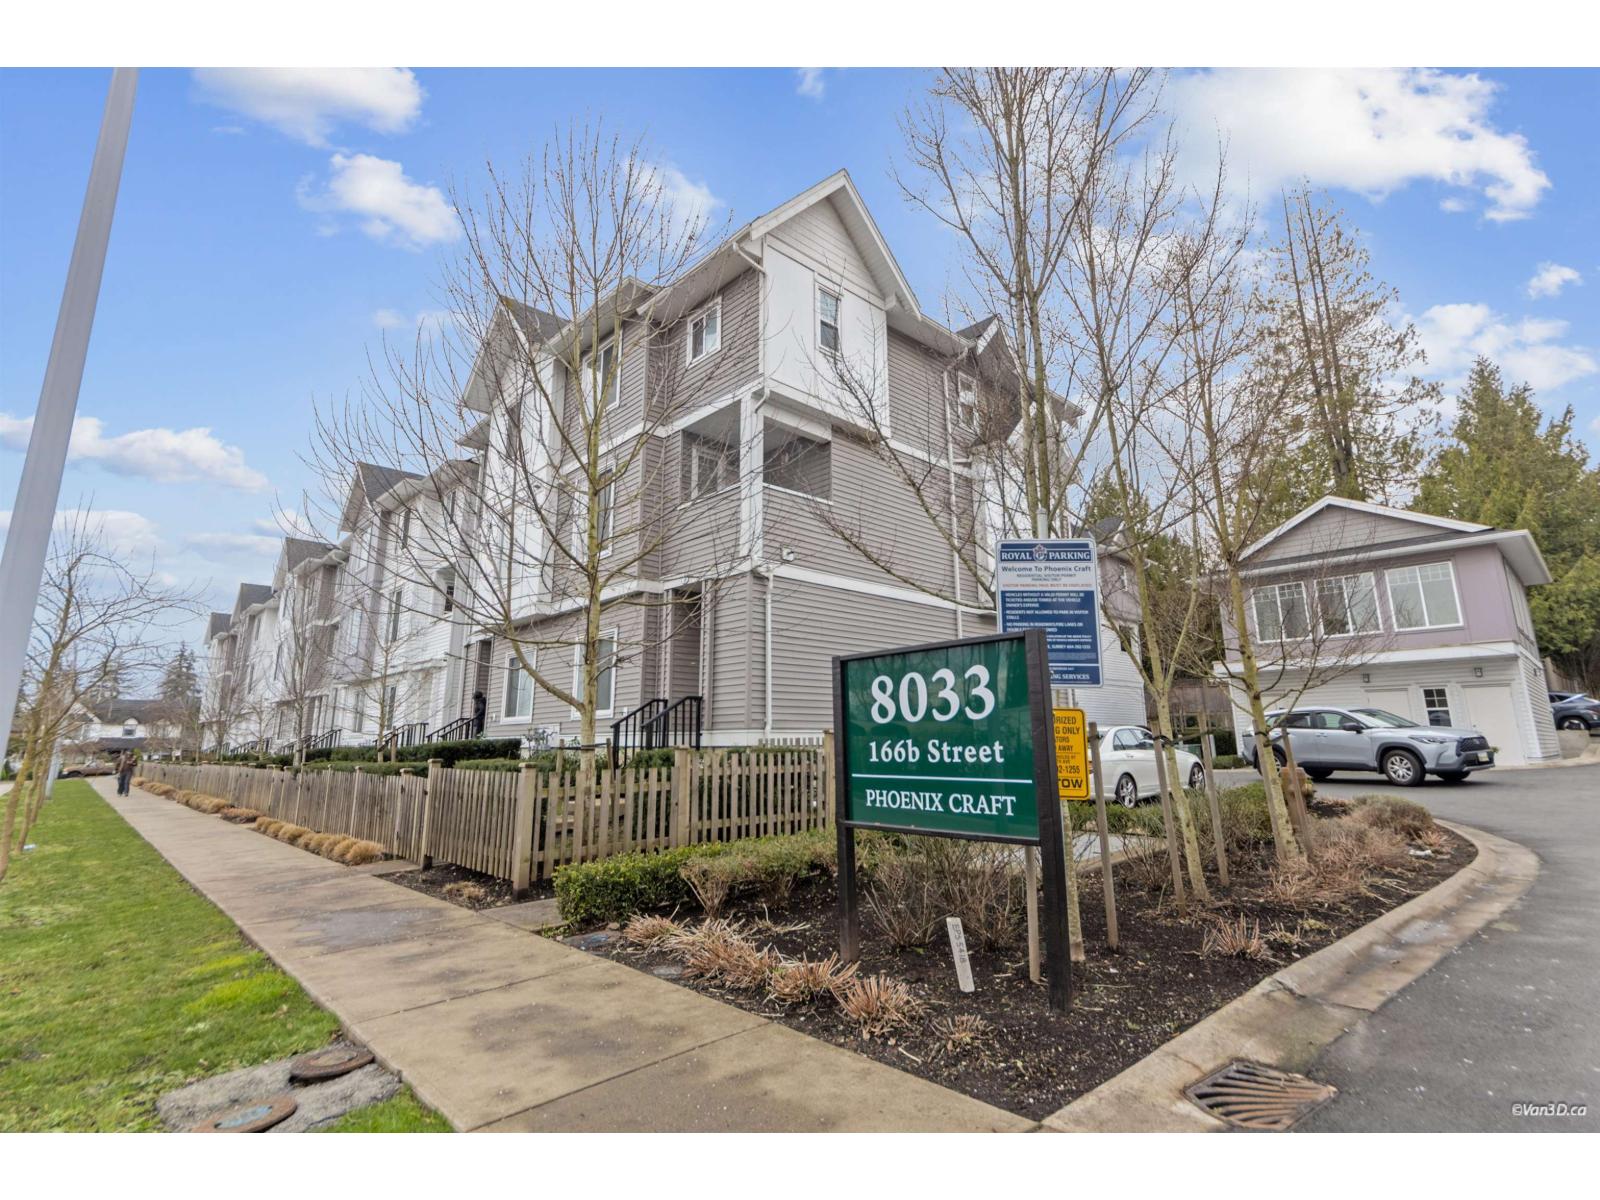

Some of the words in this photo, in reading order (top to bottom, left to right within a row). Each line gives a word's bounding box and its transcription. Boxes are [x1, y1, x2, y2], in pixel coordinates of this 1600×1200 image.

[1001, 552, 1032, 560] ROYAL
[1049, 552, 1090, 560] PARKING
[870, 664, 996, 724] 8033
[1054, 716, 1077, 724] RIZED
[1062, 726, 1081, 735] ONLY
[869, 739, 920, 763] 166b
[927, 739, 1005, 763] Street
[1056, 765, 1081, 774] 2-1255
[865, 788, 945, 812] PHOENIX
[948, 793, 1017, 816] CRAFT
